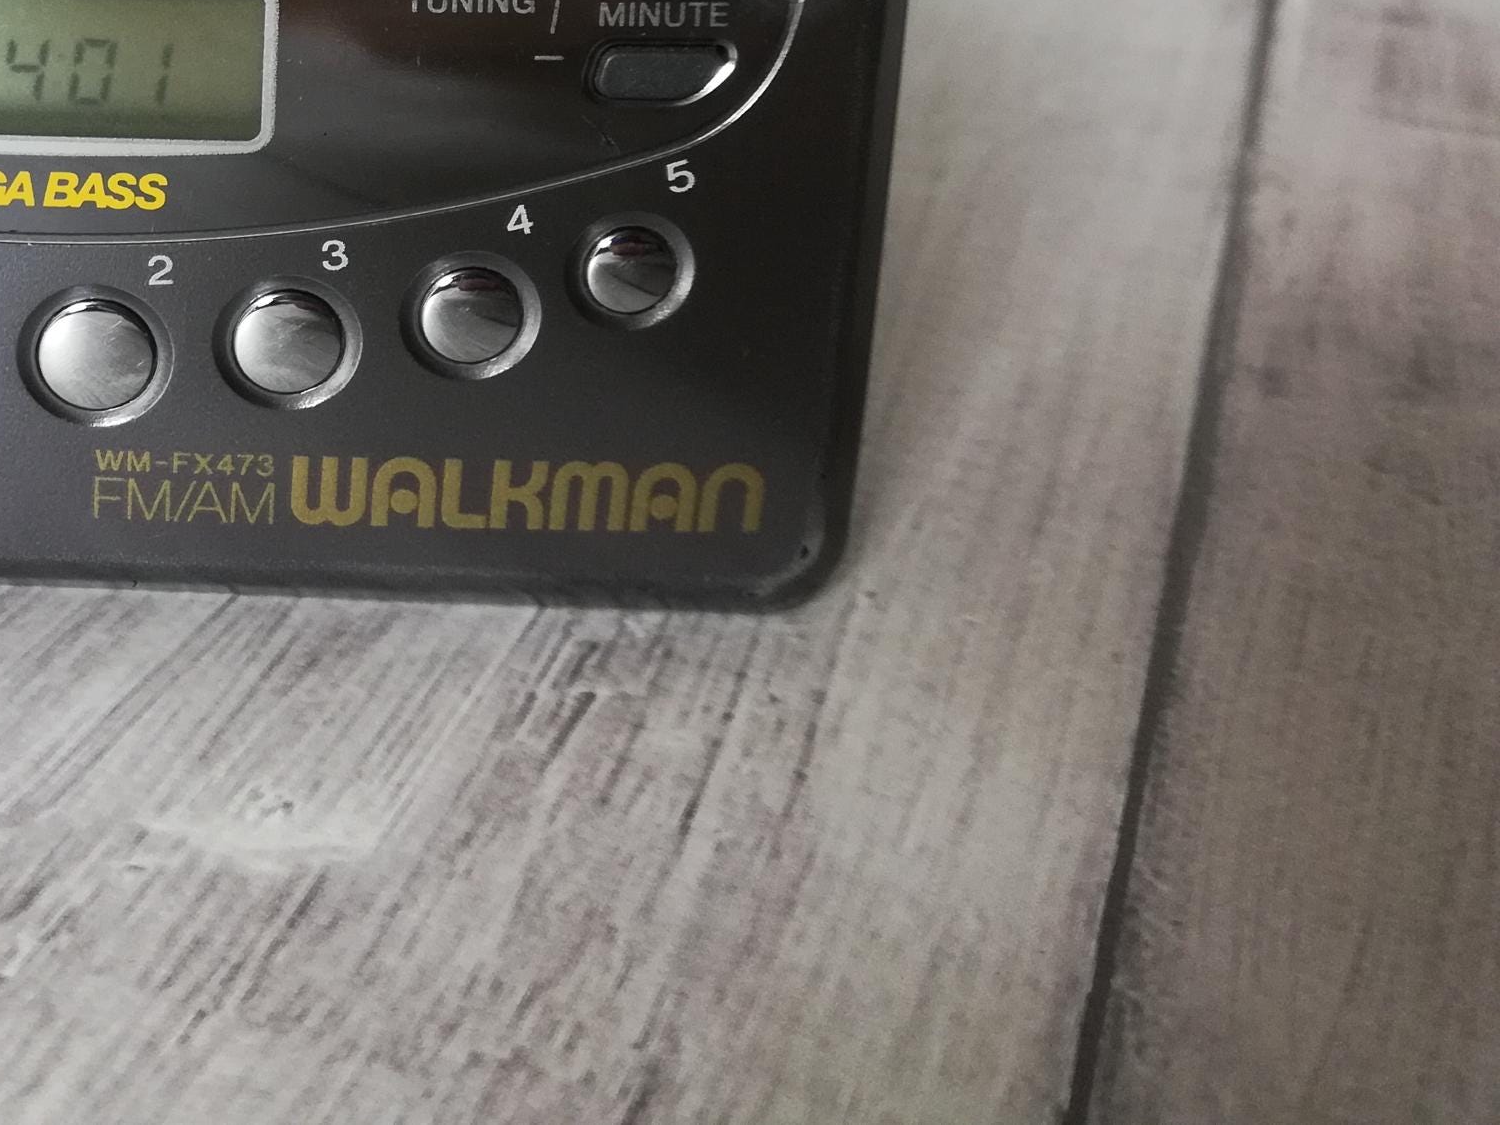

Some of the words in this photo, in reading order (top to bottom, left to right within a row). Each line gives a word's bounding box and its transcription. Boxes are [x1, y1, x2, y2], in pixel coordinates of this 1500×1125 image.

[598, 2, 730, 28] MINUTE
[43, 171, 168, 211] BASS
[665, 159, 696, 193] 5
[506, 204, 534, 236] 4
[147, 255, 175, 286] 2
[321, 239, 350, 271] 3
[95, 449, 276, 476] WM-FX473
[92, 477, 276, 526] FM/AM
[290, 454, 765, 533] WALKMAN
